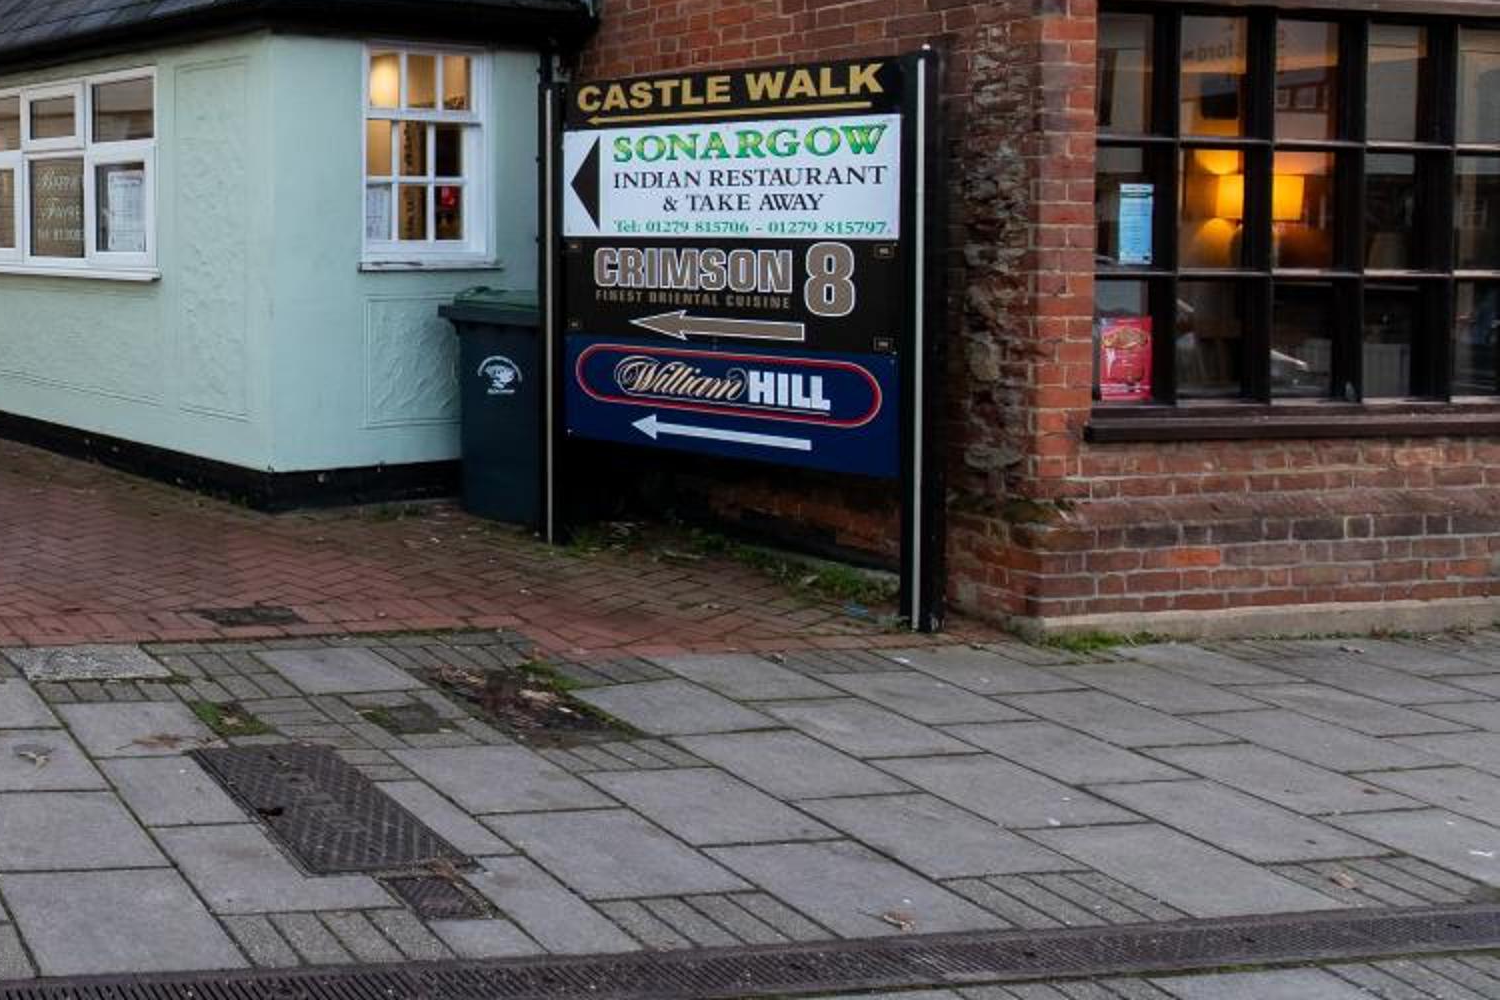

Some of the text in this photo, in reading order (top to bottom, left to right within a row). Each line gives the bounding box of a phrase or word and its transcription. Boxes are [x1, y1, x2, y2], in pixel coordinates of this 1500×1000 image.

[577, 63, 884, 112] CASTLE WALK
[613, 124, 888, 162] SONARGOW
[613, 164, 888, 190] INDIAN RESTAURANT
[662, 192, 826, 213] & TAKE AWAY
[645, 220, 690, 235] 01279
[767, 220, 818, 235] 01279
[594, 241, 855, 317] CRIMSON 8
[595, 289, 790, 310] FINEST ORIENTAL CUISINE
[615, 354, 831, 411] William HILL
